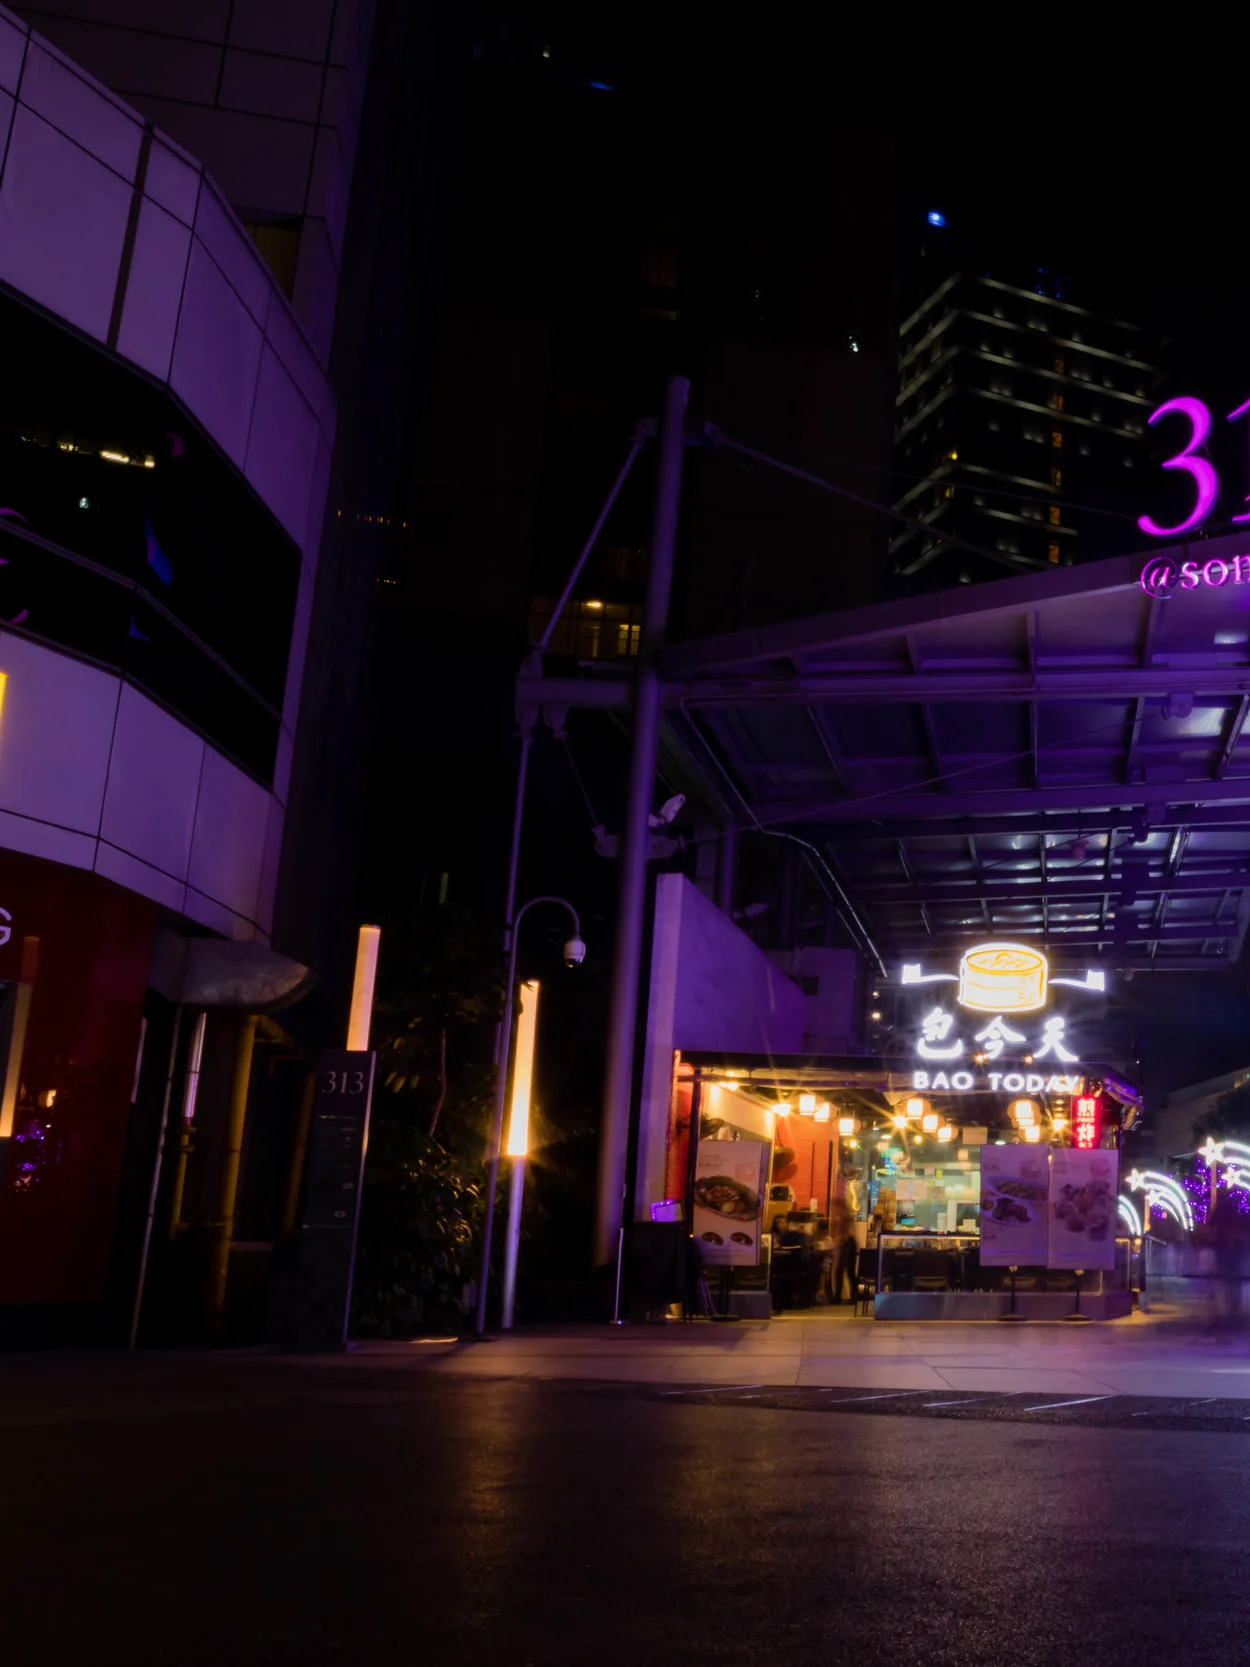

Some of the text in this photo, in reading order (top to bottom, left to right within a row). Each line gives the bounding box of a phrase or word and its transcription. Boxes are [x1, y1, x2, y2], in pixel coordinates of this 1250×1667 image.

[321, 1071, 364, 1094] 313
[913, 1071, 1080, 1093] BAO TODAY
